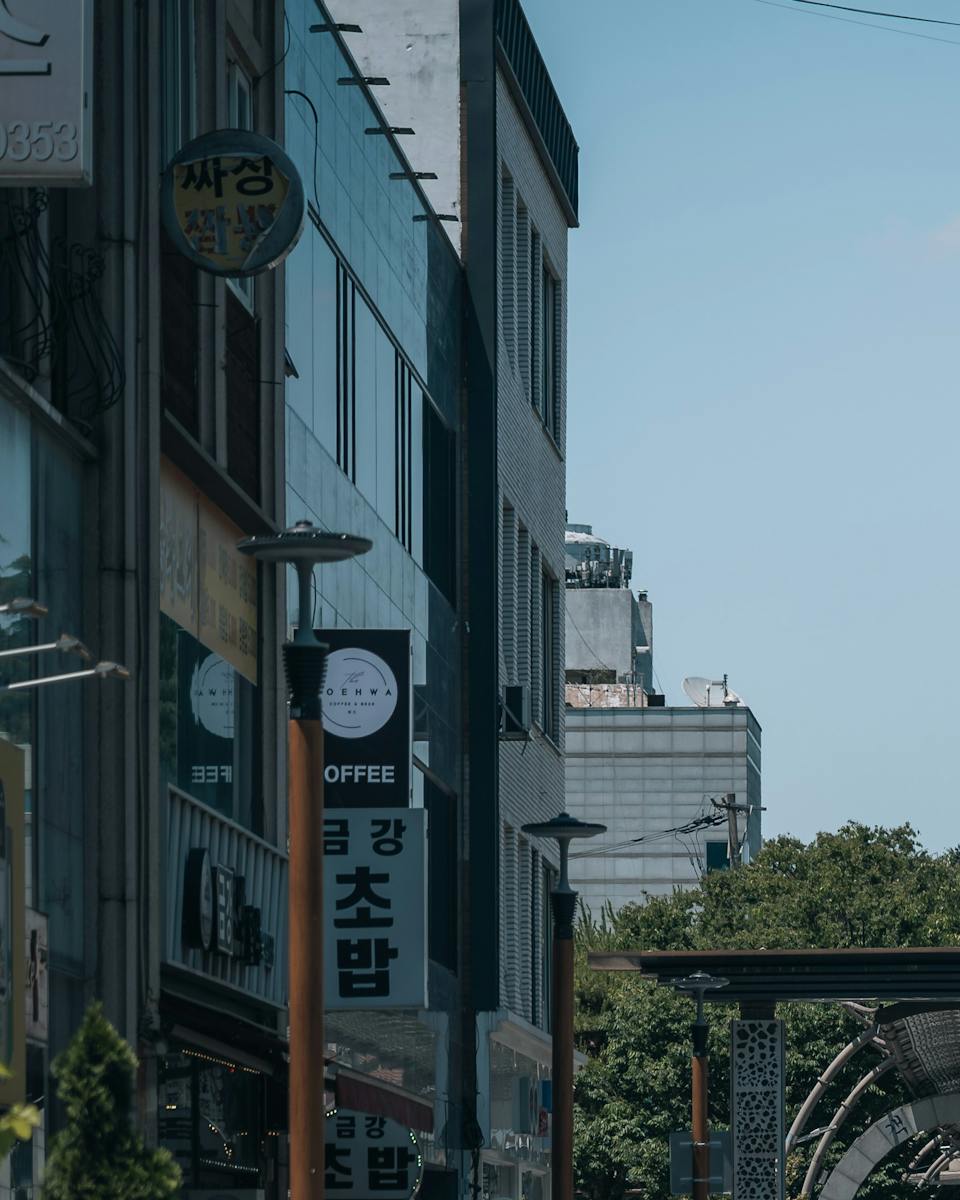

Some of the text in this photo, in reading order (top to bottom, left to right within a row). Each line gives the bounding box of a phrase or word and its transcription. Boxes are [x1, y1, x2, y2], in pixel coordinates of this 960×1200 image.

[326, 687, 393, 697] OEHWA
[324, 765, 395, 784] OFFEE
[324, 818, 406, 857] 금강
[333, 866, 399, 998] 초밥
[336, 1116, 387, 1139] 금강
